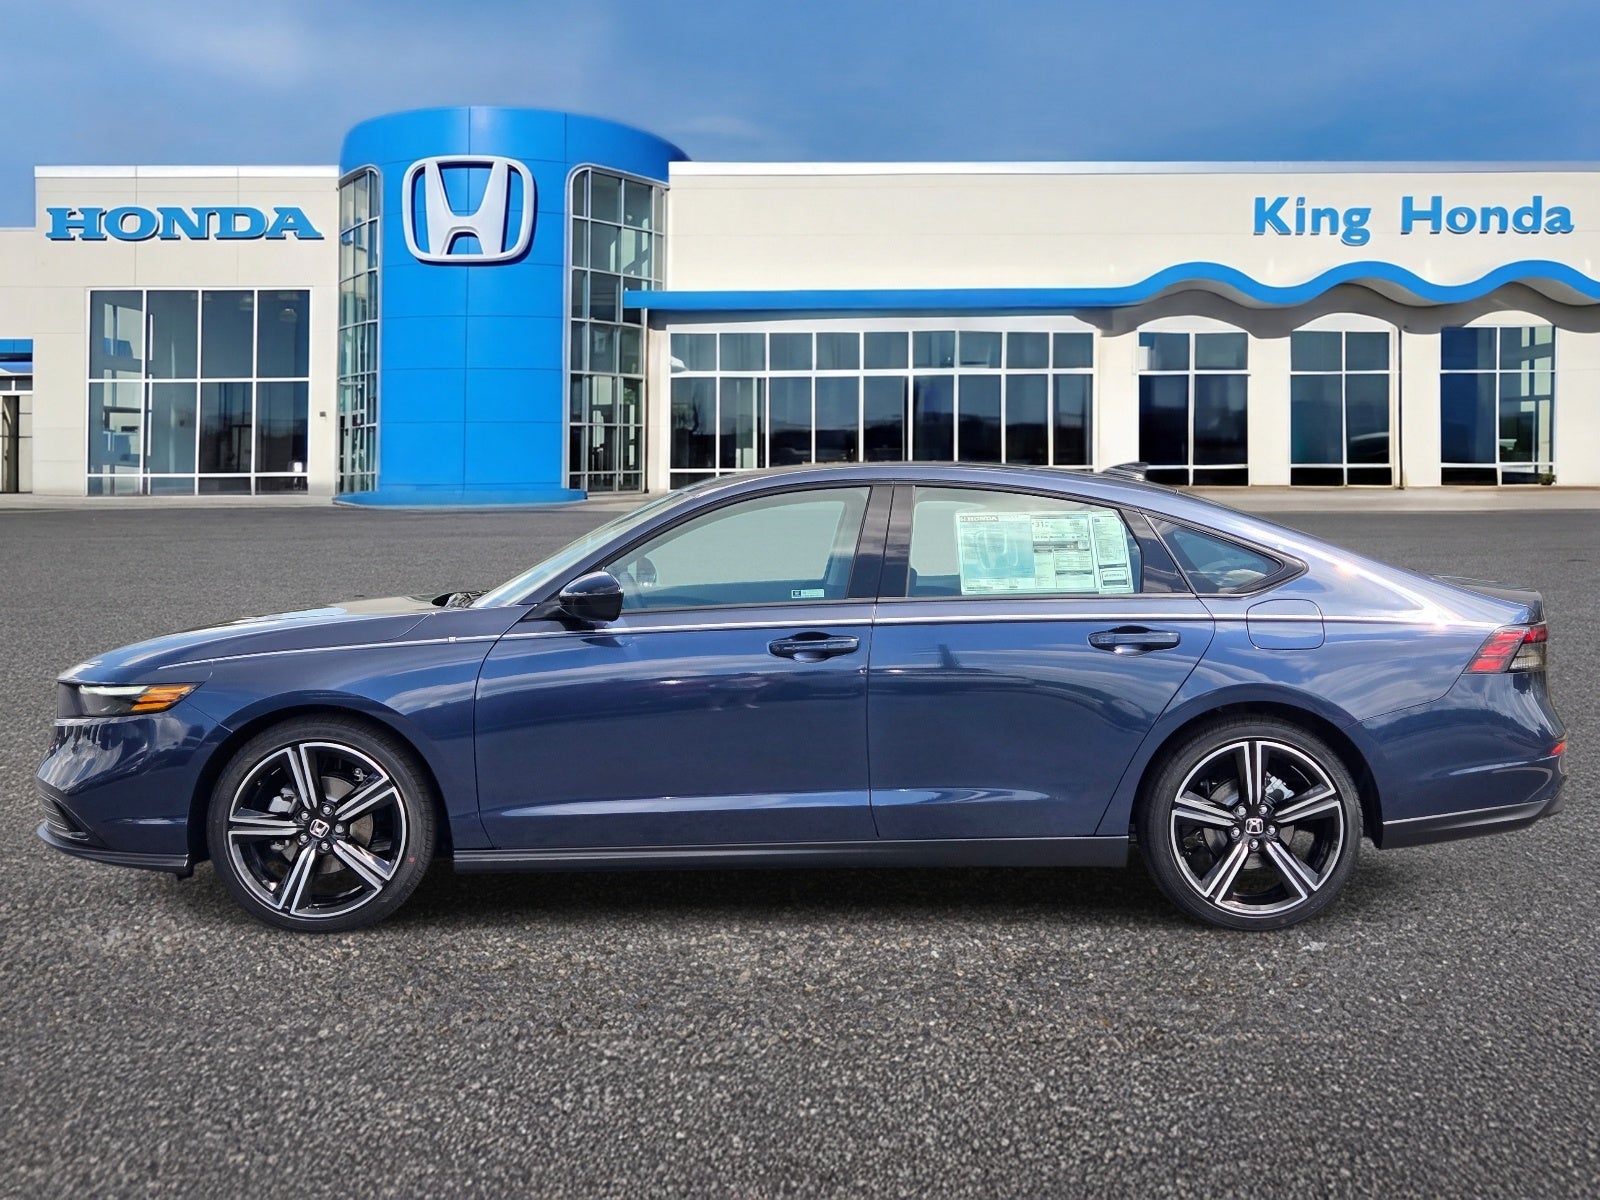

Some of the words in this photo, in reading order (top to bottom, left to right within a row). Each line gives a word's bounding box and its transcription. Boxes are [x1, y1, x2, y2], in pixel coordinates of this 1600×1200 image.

[46, 206, 325, 241] HONDA
[1253, 196, 1372, 246] King
[1400, 195, 1575, 235] Honda
